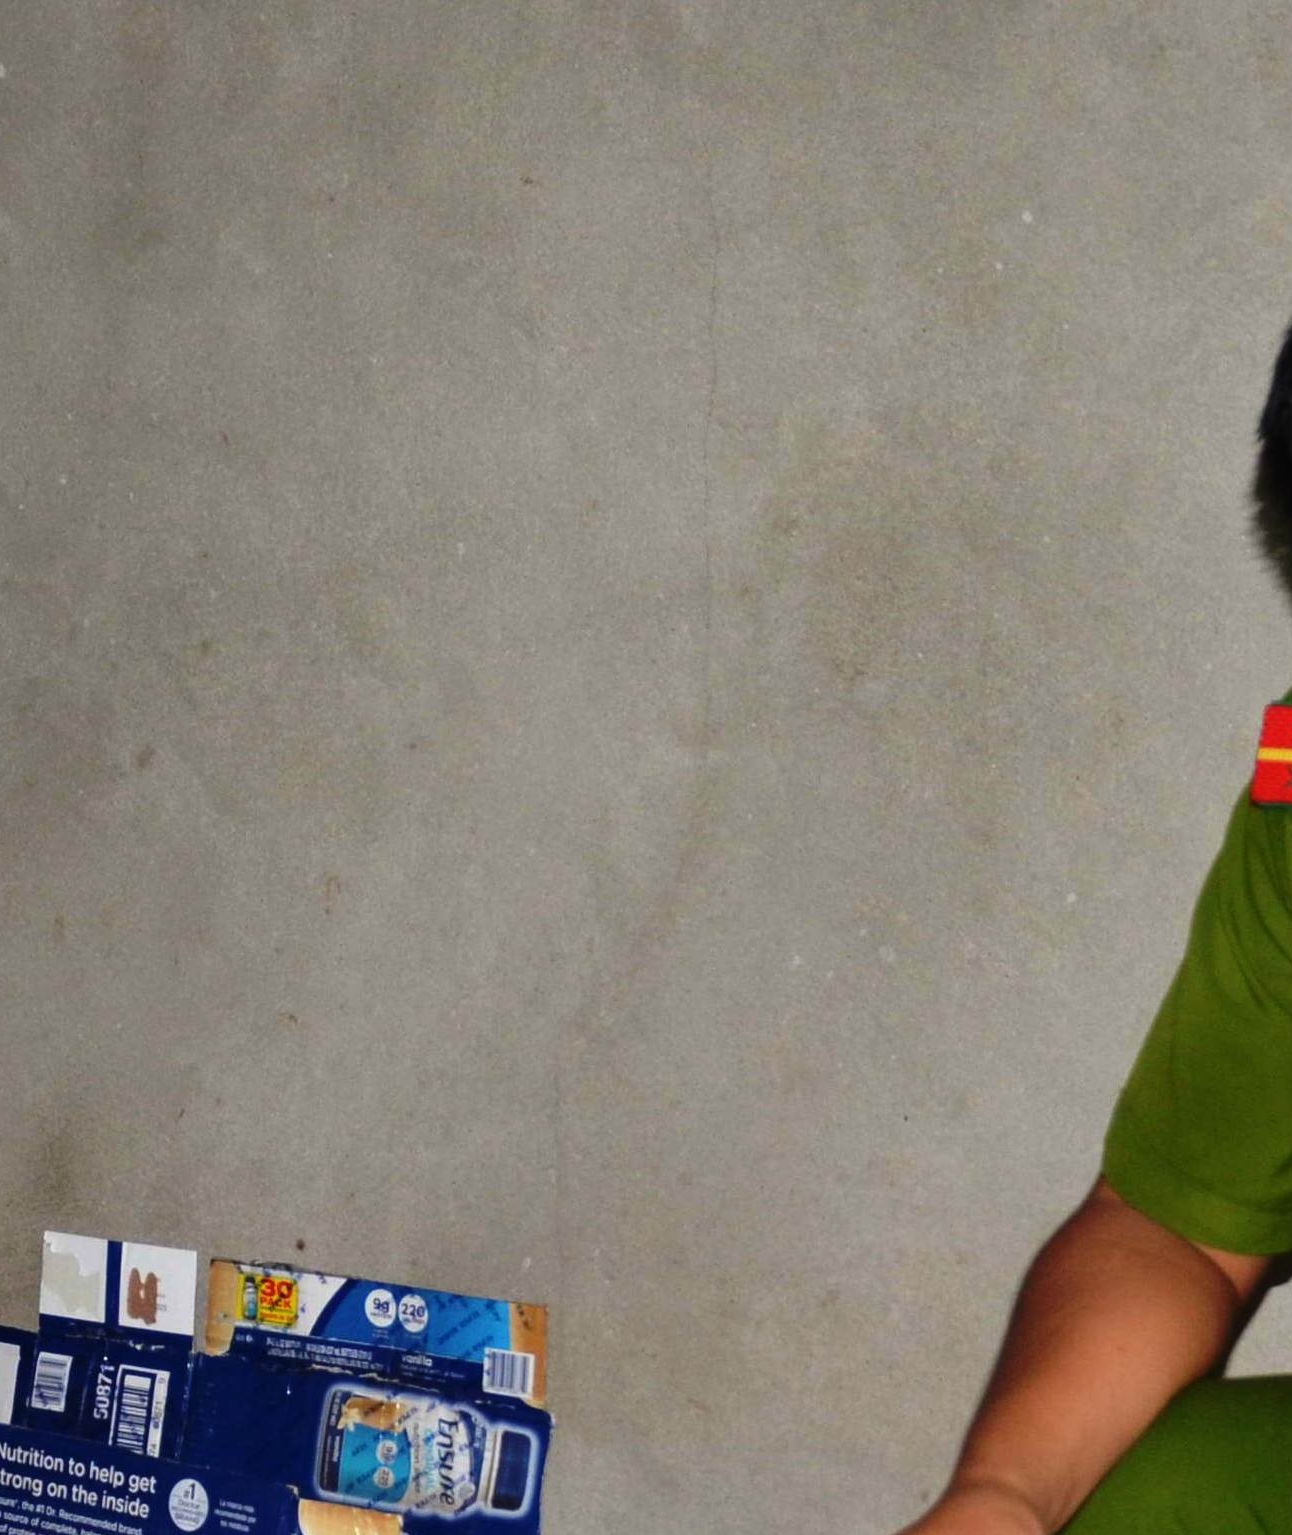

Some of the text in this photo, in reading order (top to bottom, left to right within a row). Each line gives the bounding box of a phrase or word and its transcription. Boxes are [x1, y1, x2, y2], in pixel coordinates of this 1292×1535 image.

[260, 1278, 293, 1299] 30
[260, 1298, 292, 1309] PACK
[373, 1297, 389, 1313] 9g
[94, 1365, 115, 1419] 50871
[438, 1419, 459, 1505] Ensure
[68, 1458, 85, 1477] to
[89, 1461, 125, 1487] help
[129, 1474, 157, 1493] get
[47, 1481, 67, 1499] on
[72, 1485, 98, 1506] the
[102, 1491, 149, 1518] inside
[0, 1524, 8, 1533] of
[4, 1511, 29, 1525] source
[30, 1516, 39, 1526] of
[21, 1501, 34, 1512] the
[47, 1506, 57, 1517] Dr.
[59, 1509, 117, 1531] Recommended
